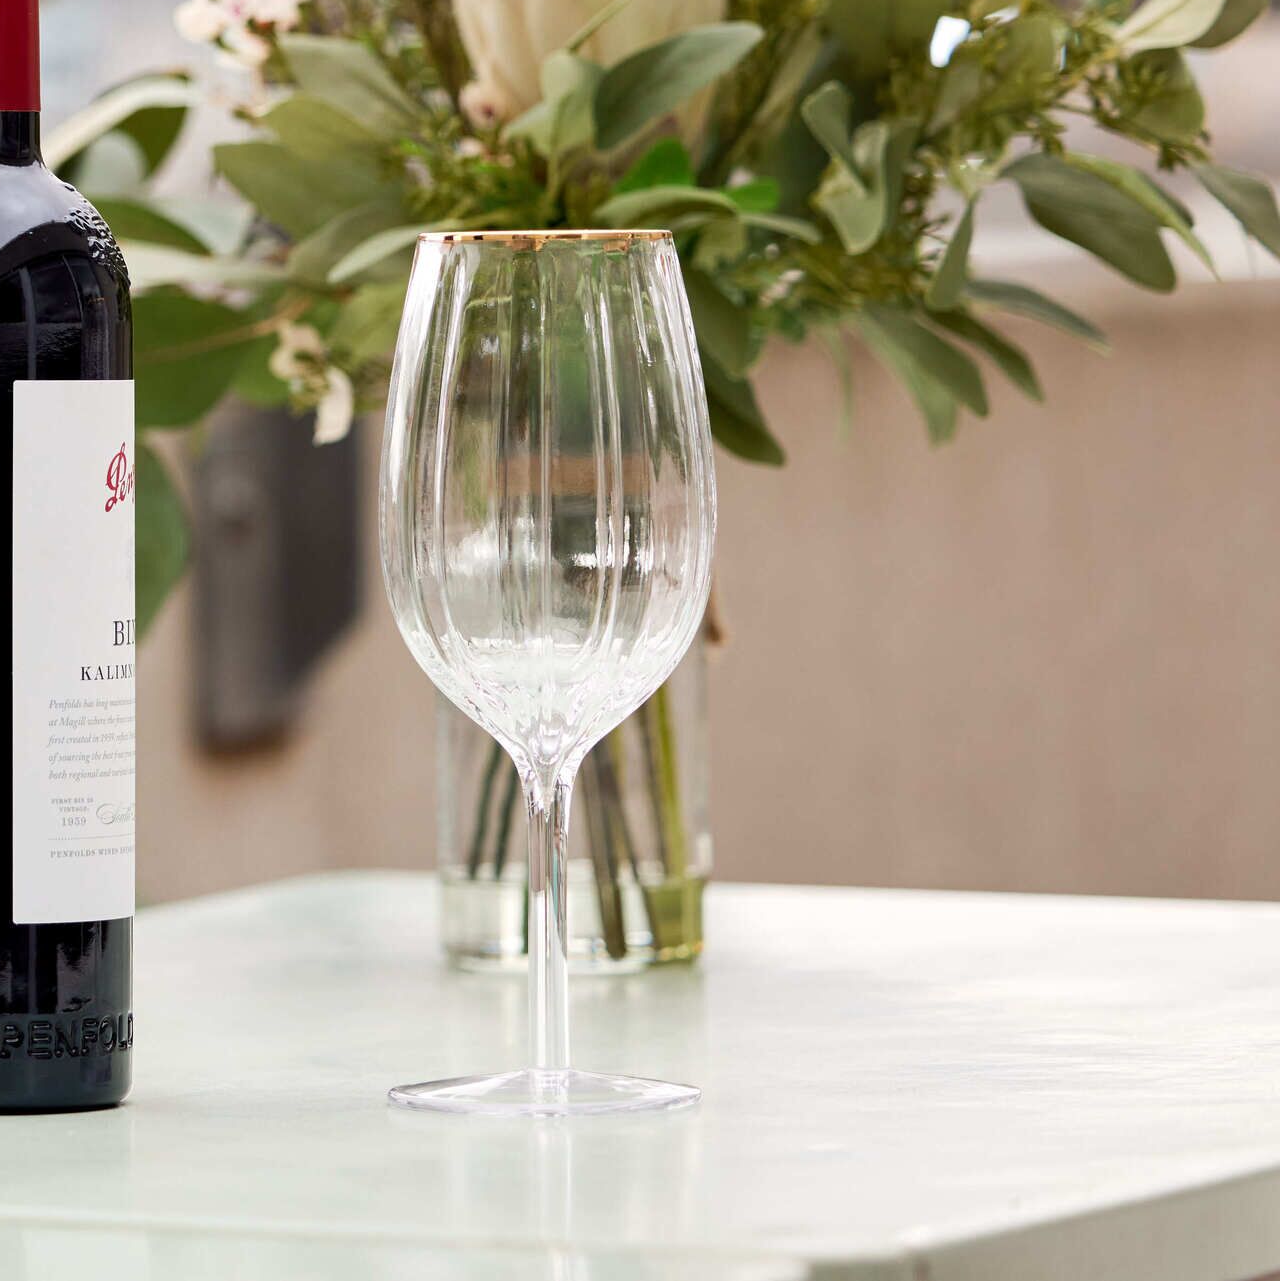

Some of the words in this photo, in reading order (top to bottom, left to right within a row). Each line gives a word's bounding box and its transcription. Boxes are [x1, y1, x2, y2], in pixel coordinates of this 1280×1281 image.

[48, 699, 81, 712] Penfolds
[48, 719, 58, 727] at
[59, 716, 87, 730] Magill
[46, 735, 66, 748] first
[66, 732, 92, 744] created
[48, 752, 58, 764] of
[58, 753, 90, 763] sourcing
[48, 770, 67, 780] both
[68, 768, 98, 782] regional
[61, 816, 87, 827] 1959
[50, 848, 96, 859] PENFOLDS
